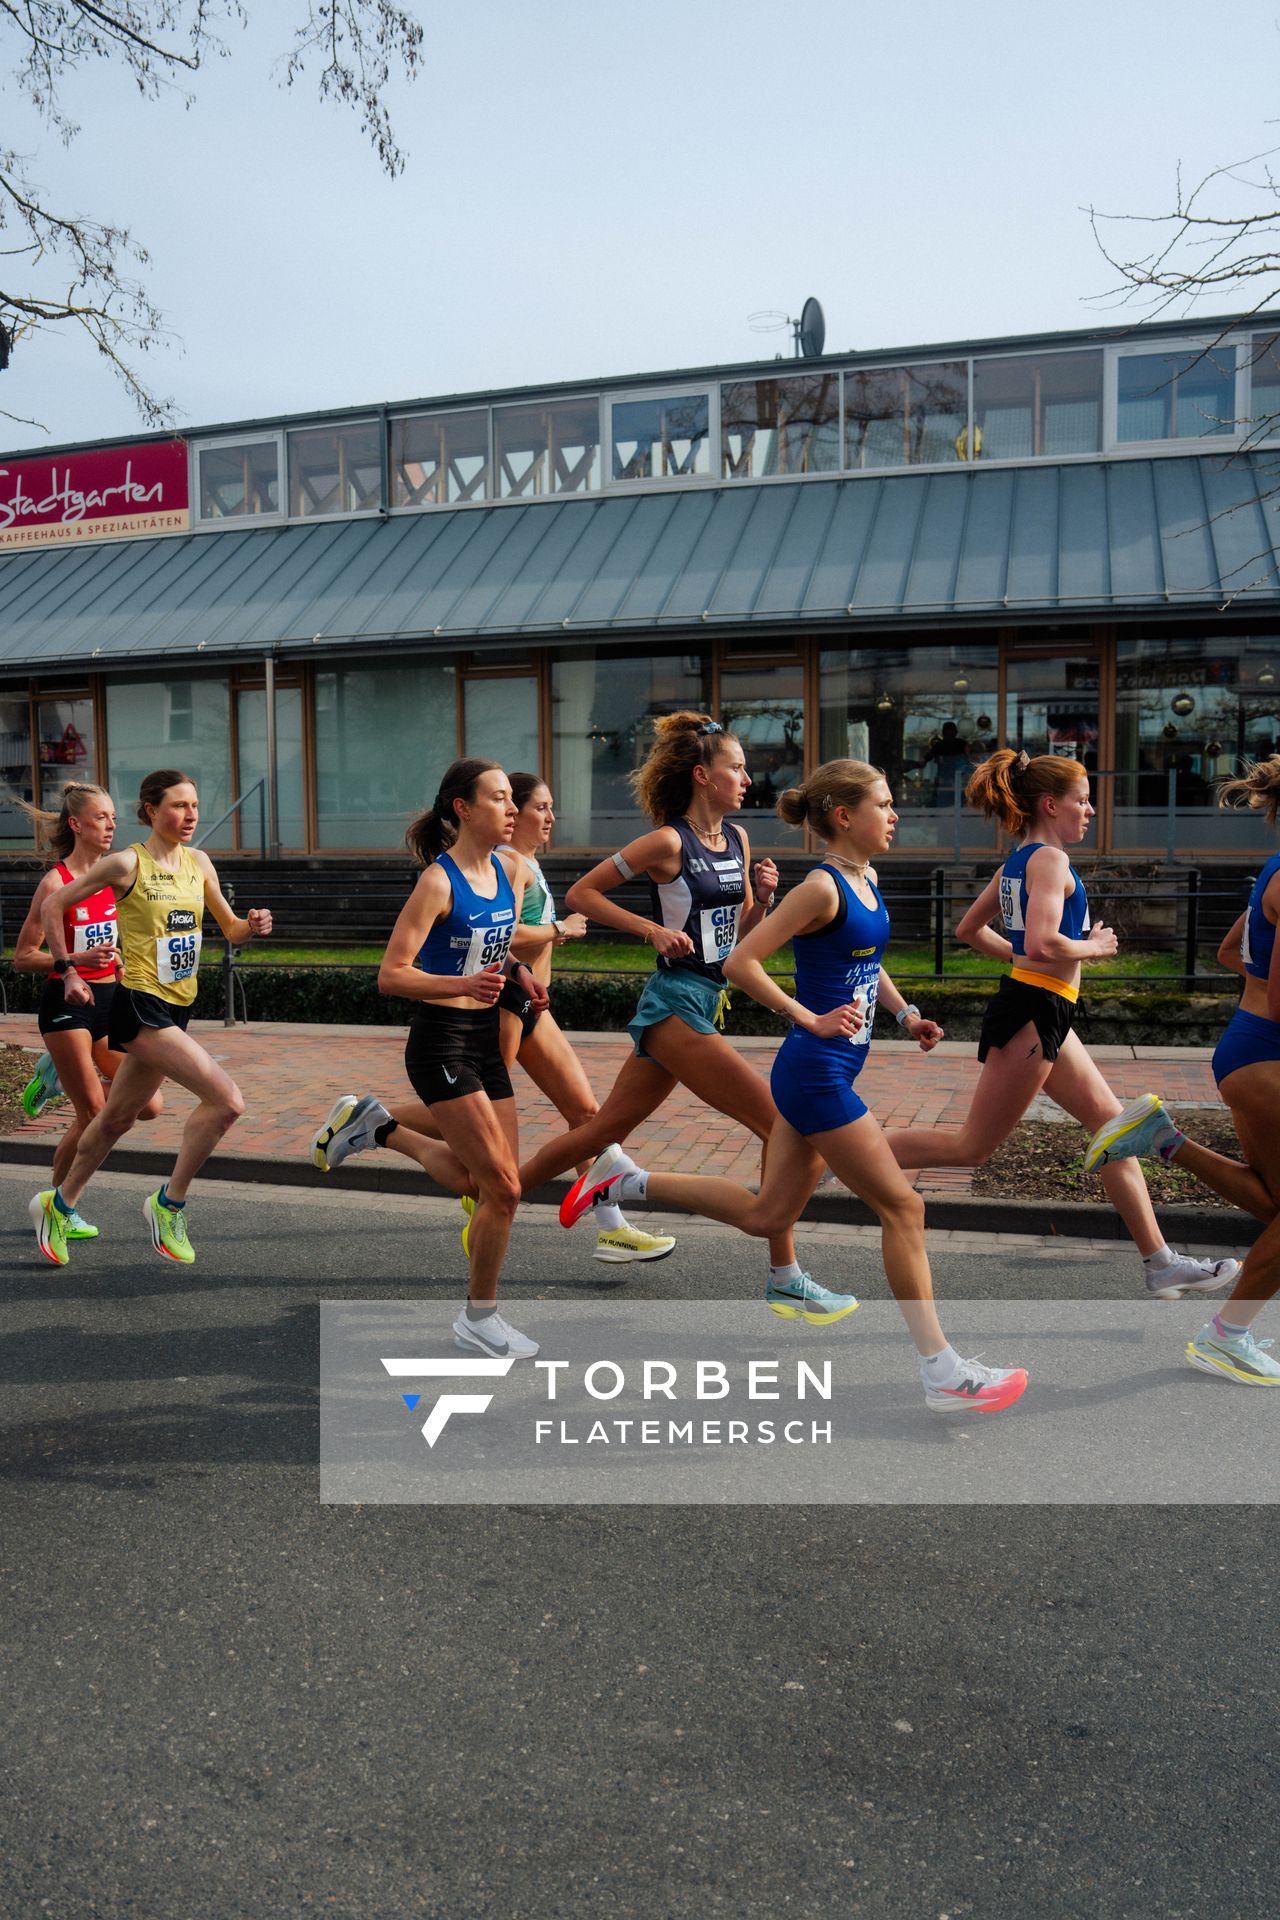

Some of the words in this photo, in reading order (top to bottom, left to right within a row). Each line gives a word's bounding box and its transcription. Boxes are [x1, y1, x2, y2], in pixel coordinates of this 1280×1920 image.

[0, 528, 71, 543] KAFFEEHAUS
[76, 527, 83, 536] &
[88, 516, 182, 534] SPEZIALITÄTEN
[719, 882, 742, 892] VIACTIV
[146, 892, 177, 902] infinex
[170, 915, 194, 924] HOKA
[711, 906, 737, 926] GLS
[85, 922, 112, 938] GLS
[484, 925, 513, 945] GLS
[714, 923, 735, 947] 659
[168, 935, 195, 953] GLS
[481, 941, 510, 964] 925
[170, 950, 195, 971] 939
[607, 1239, 638, 1251] RUNNING
